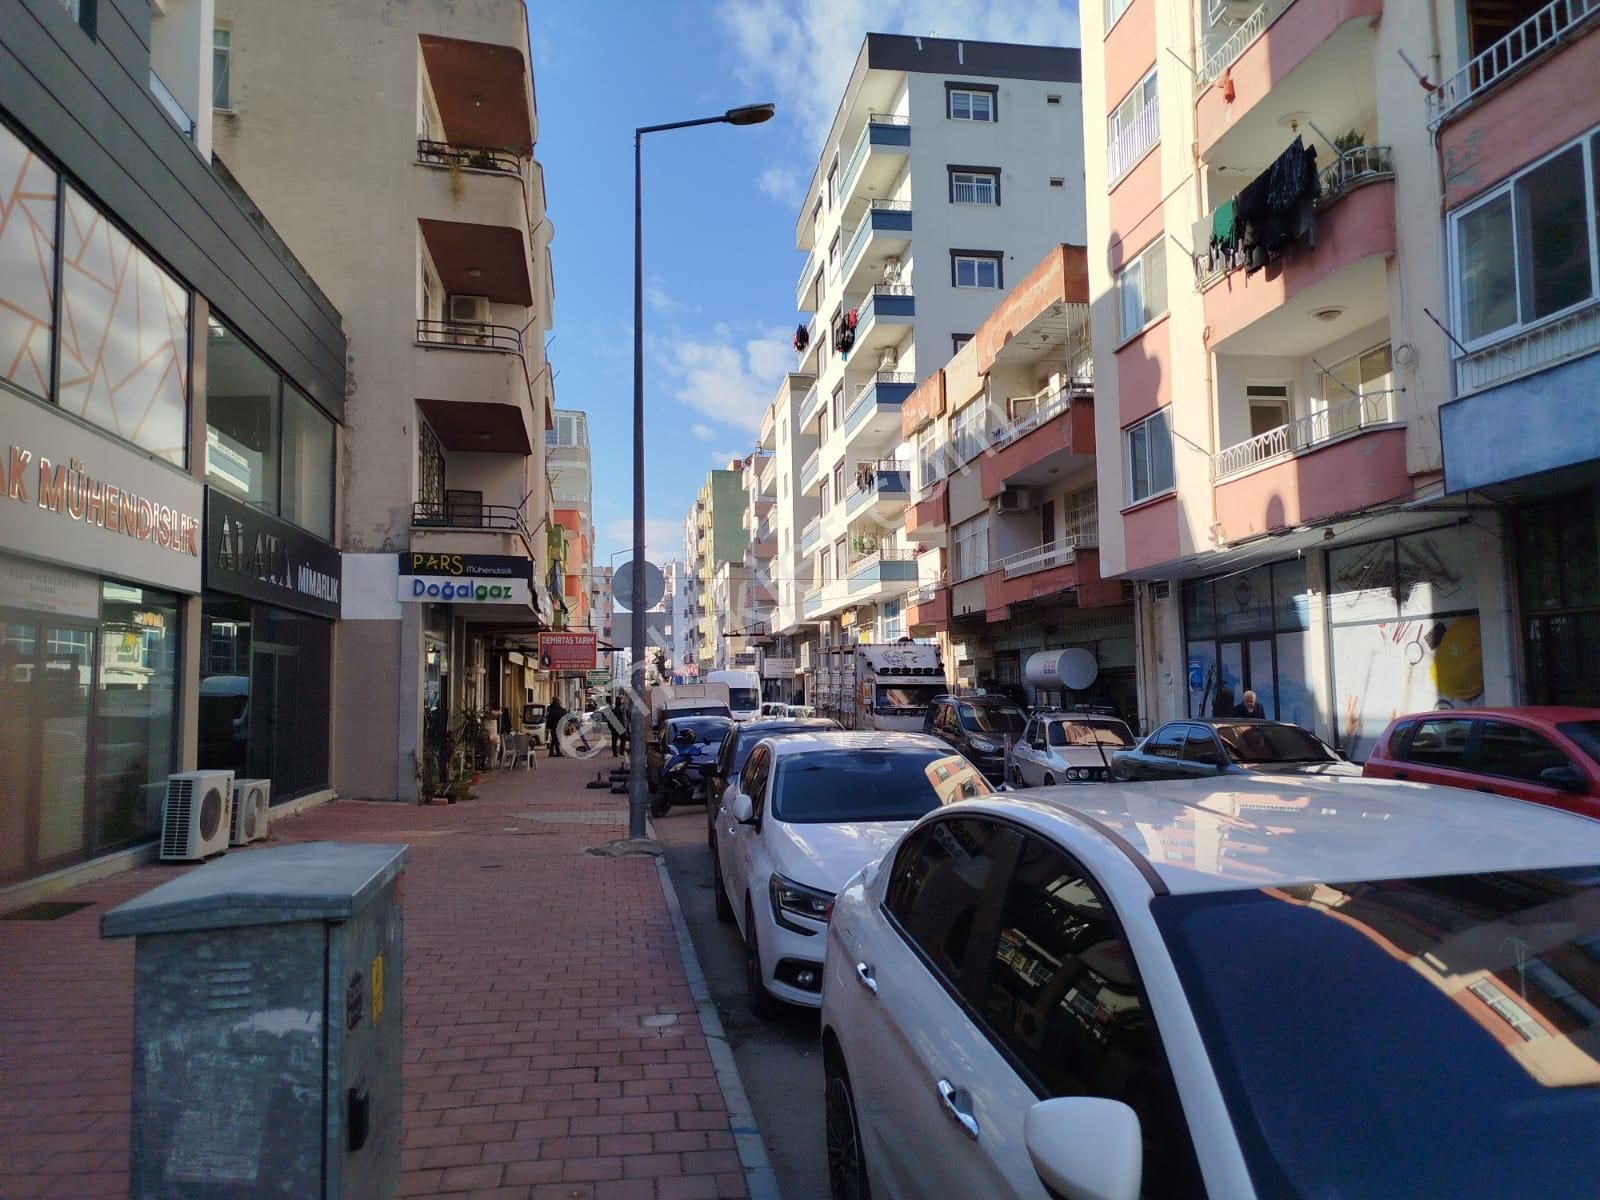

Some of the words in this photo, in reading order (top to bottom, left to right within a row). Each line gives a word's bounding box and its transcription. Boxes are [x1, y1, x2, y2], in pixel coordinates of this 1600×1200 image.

[413, 553, 463, 575] PARS
[298, 561, 338, 604] MİMARLIK
[413, 578, 513, 600] Doğalgaz
[575, 636, 594, 645] TARIM
